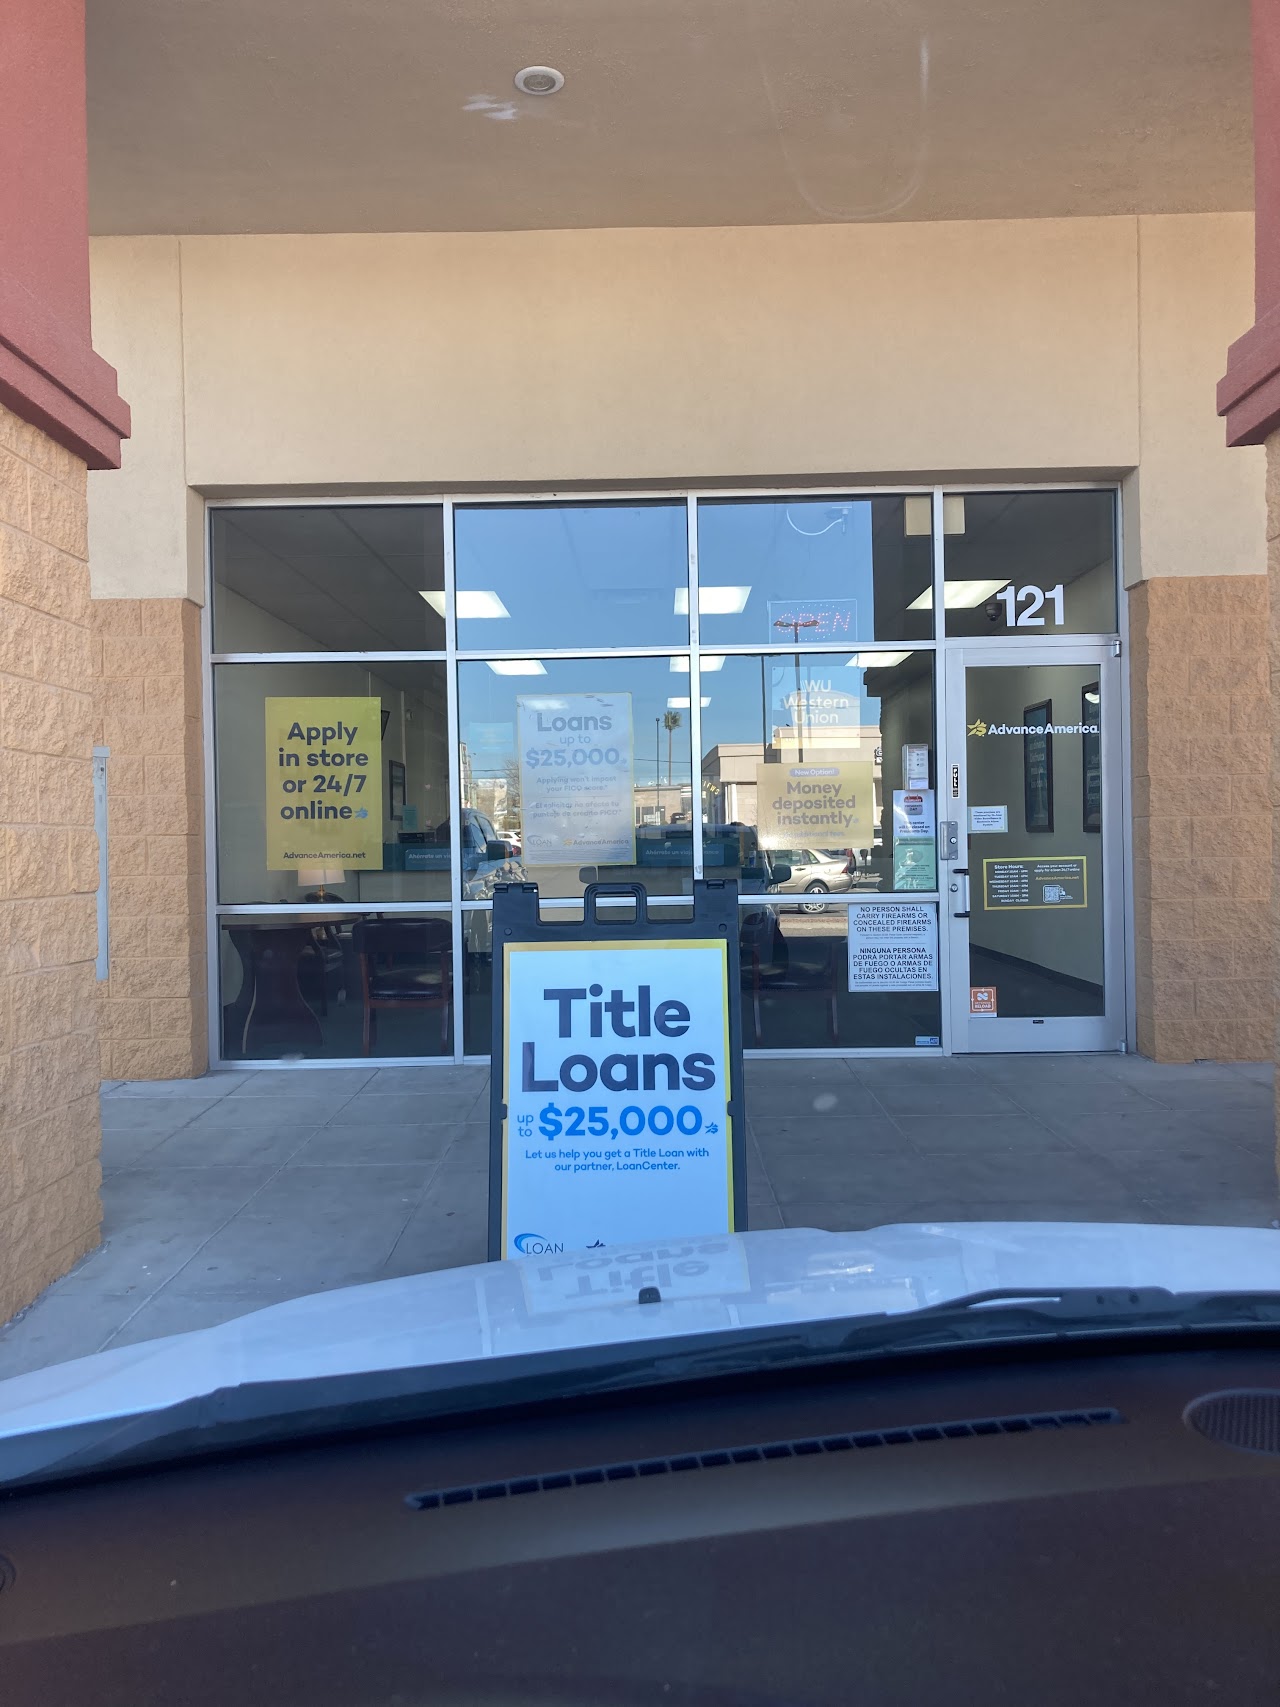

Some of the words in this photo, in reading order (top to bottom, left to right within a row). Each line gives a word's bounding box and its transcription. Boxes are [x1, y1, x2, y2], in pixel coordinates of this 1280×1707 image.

[997, 584, 1065, 627] 121
[777, 611, 851, 633] OPEN
[783, 696, 849, 709] Western
[537, 712, 612, 731] Loans
[794, 710, 839, 724] Union
[287, 721, 358, 745] Apply
[560, 736, 575, 746] up
[578, 734, 591, 744] to
[279, 747, 299, 766] in
[306, 749, 368, 766] store
[525, 748, 620, 769] $25,000
[282, 779, 306, 793] or
[313, 774, 367, 796] 24/7
[536, 776, 569, 785] Applying
[592, 776, 616, 784] impact
[786, 781, 842, 797] Money
[280, 800, 353, 819] online
[772, 795, 856, 813] deposited
[777, 811, 853, 828] instantly
[544, 984, 690, 1038] Title
[522, 1042, 716, 1092] Loans
[517, 1114, 534, 1125] up
[538, 1103, 702, 1140] $25,000
[518, 1126, 532, 1137] to
[526, 1150, 542, 1159] Let
[559, 1149, 581, 1160] help
[584, 1151, 602, 1161] you
[604, 1150, 621, 1160] get
[633, 1148, 656, 1158] Title
[659, 1148, 684, 1157] Loan
[686, 1148, 709, 1157] with
[574, 1162, 614, 1173] partner,
[617, 1161, 680, 1170] LoanCenter.
[526, 1243, 564, 1254] LOAN
